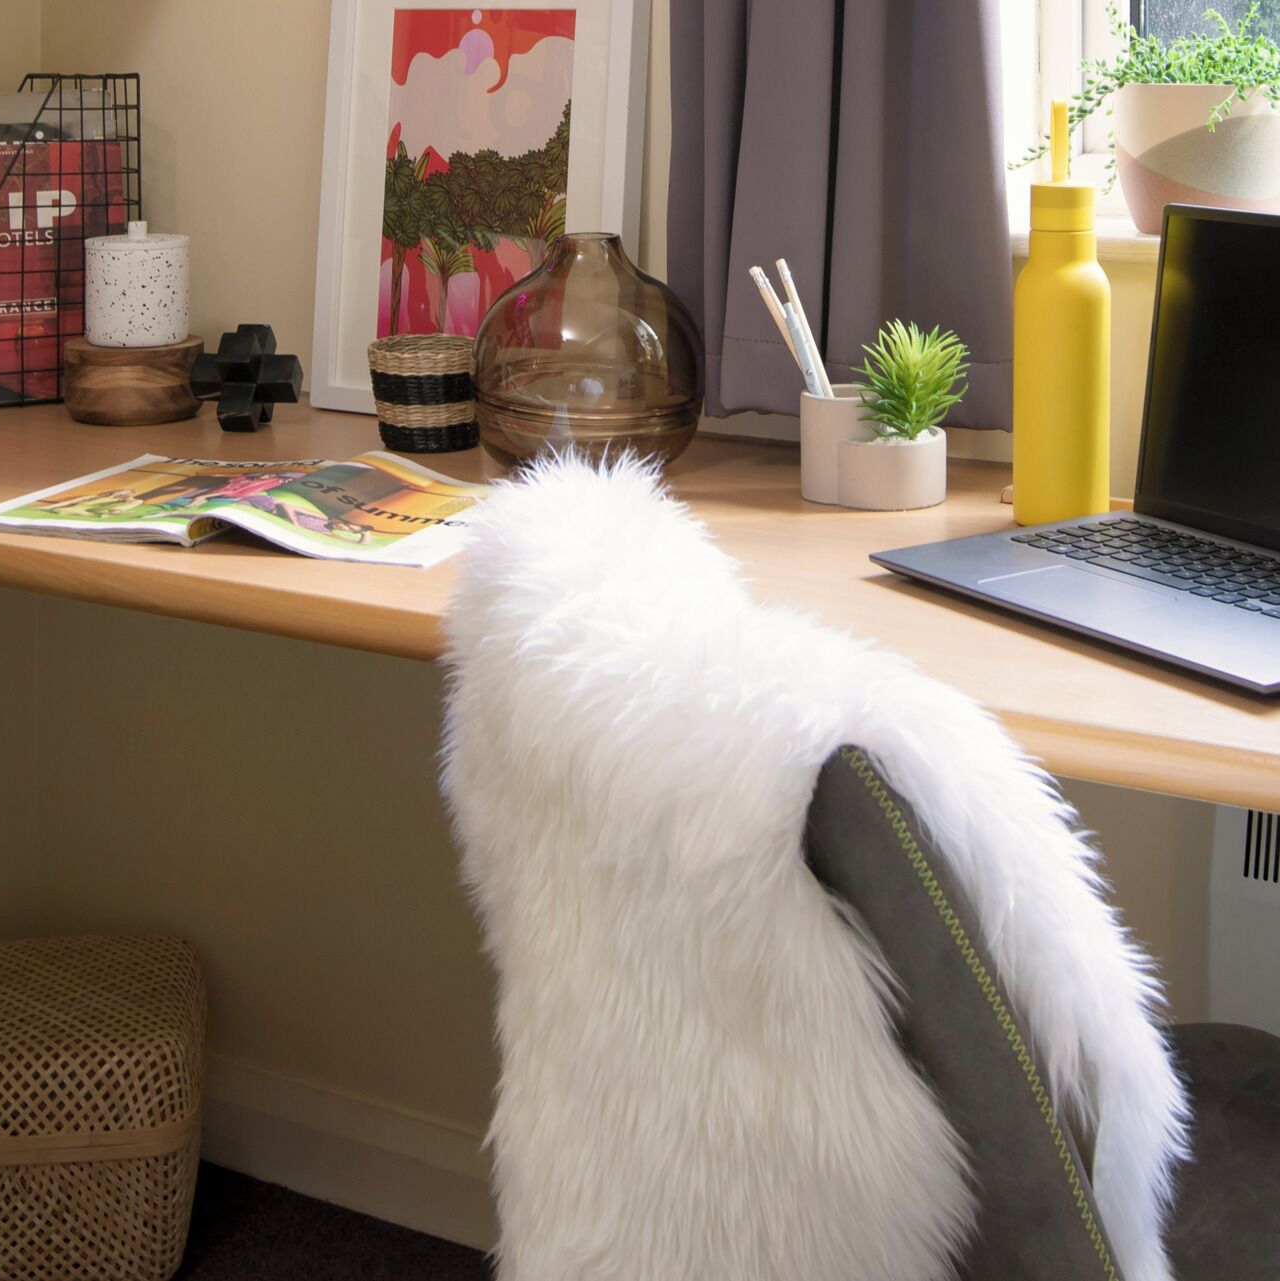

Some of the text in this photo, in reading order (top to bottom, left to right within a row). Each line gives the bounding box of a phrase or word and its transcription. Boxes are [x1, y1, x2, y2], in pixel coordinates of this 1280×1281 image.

[165, 457, 325, 468] The sound
[300, 480, 466, 528] of summe
